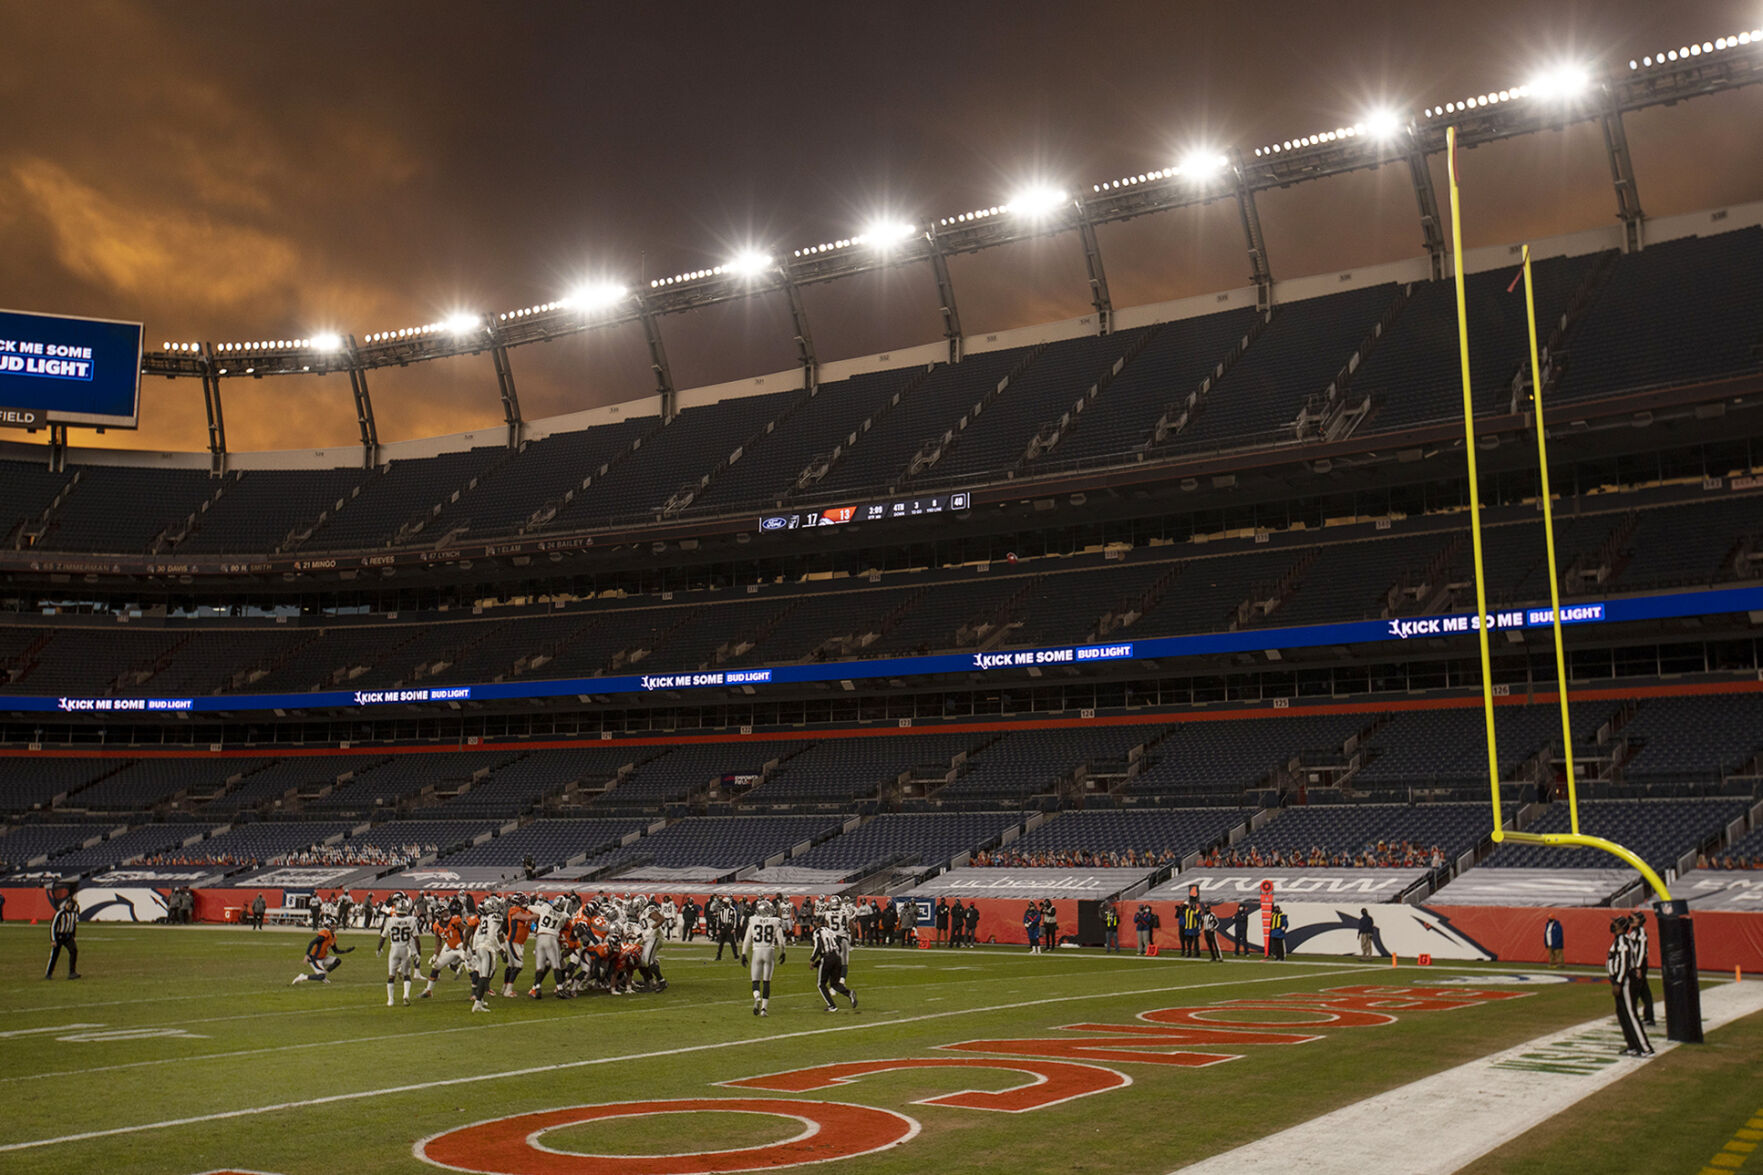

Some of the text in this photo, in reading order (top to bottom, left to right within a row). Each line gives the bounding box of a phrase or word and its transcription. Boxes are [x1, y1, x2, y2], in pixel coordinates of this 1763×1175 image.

[20, 342, 44, 354] ME
[47, 345, 92, 358] SOME
[27, 358, 90, 377] LIGHT
[954, 497, 963, 506] 40
[807, 513, 818, 525] 17
[840, 509, 850, 520] 13
[303, 559, 337, 568] 21 MINGO
[1402, 619, 1440, 634] KICK
[1442, 617, 1467, 631] ME
[1560, 607, 1600, 620] LIGHT
[984, 646, 1131, 667] KICK ME SOME BUD LIGHT
[649, 672, 770, 687] KICK ME SOME BUD LIGHT
[361, 692, 384, 702] KICK
[385, 692, 399, 701] ME
[431, 690, 447, 699] BUD
[447, 689, 469, 698] LIGHT
[1493, 685, 1509, 695] 126
[68, 700, 95, 710] KICK
[96, 700, 113, 709] ME
[114, 700, 146, 709] SOME
[167, 701, 192, 709] LIGHT
[1274, 699, 1289, 708] 125
[1081, 709, 1094, 718] 124
[741, 726, 752, 734] 122
[899, 719, 911, 727] 123
[1170, 877, 1398, 892] ARROW
[541, 915, 559, 930] 91
[831, 915, 848, 932] 54
[391, 926, 411, 943] 26
[753, 924, 774, 943] 38
[196, 984, 1540, 1175] BRONCO
